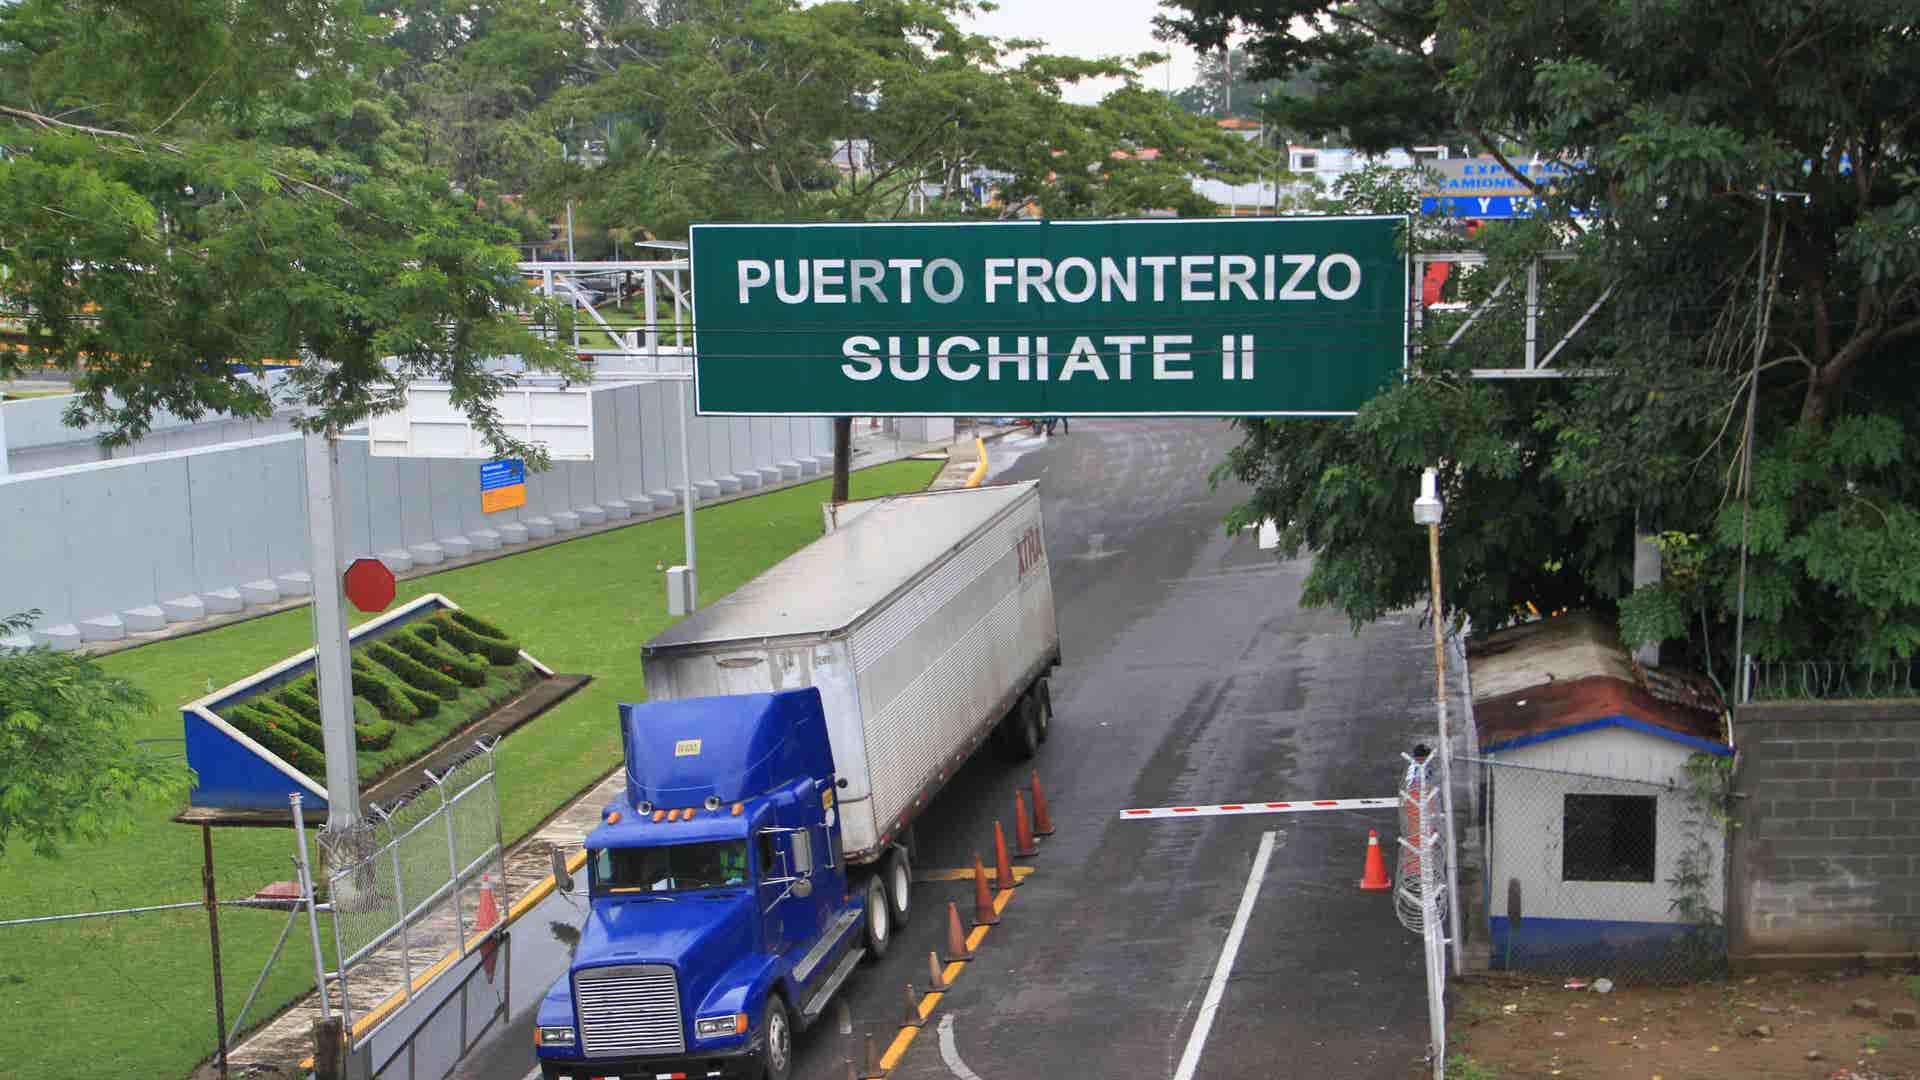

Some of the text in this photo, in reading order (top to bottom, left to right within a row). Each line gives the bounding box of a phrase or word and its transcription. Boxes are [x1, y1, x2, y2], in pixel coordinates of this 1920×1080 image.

[1477, 198, 1491, 214] Y
[737, 252, 1362, 304] PUERTO FRONTERIZO
[841, 334, 1255, 382] SUCHIATE II
